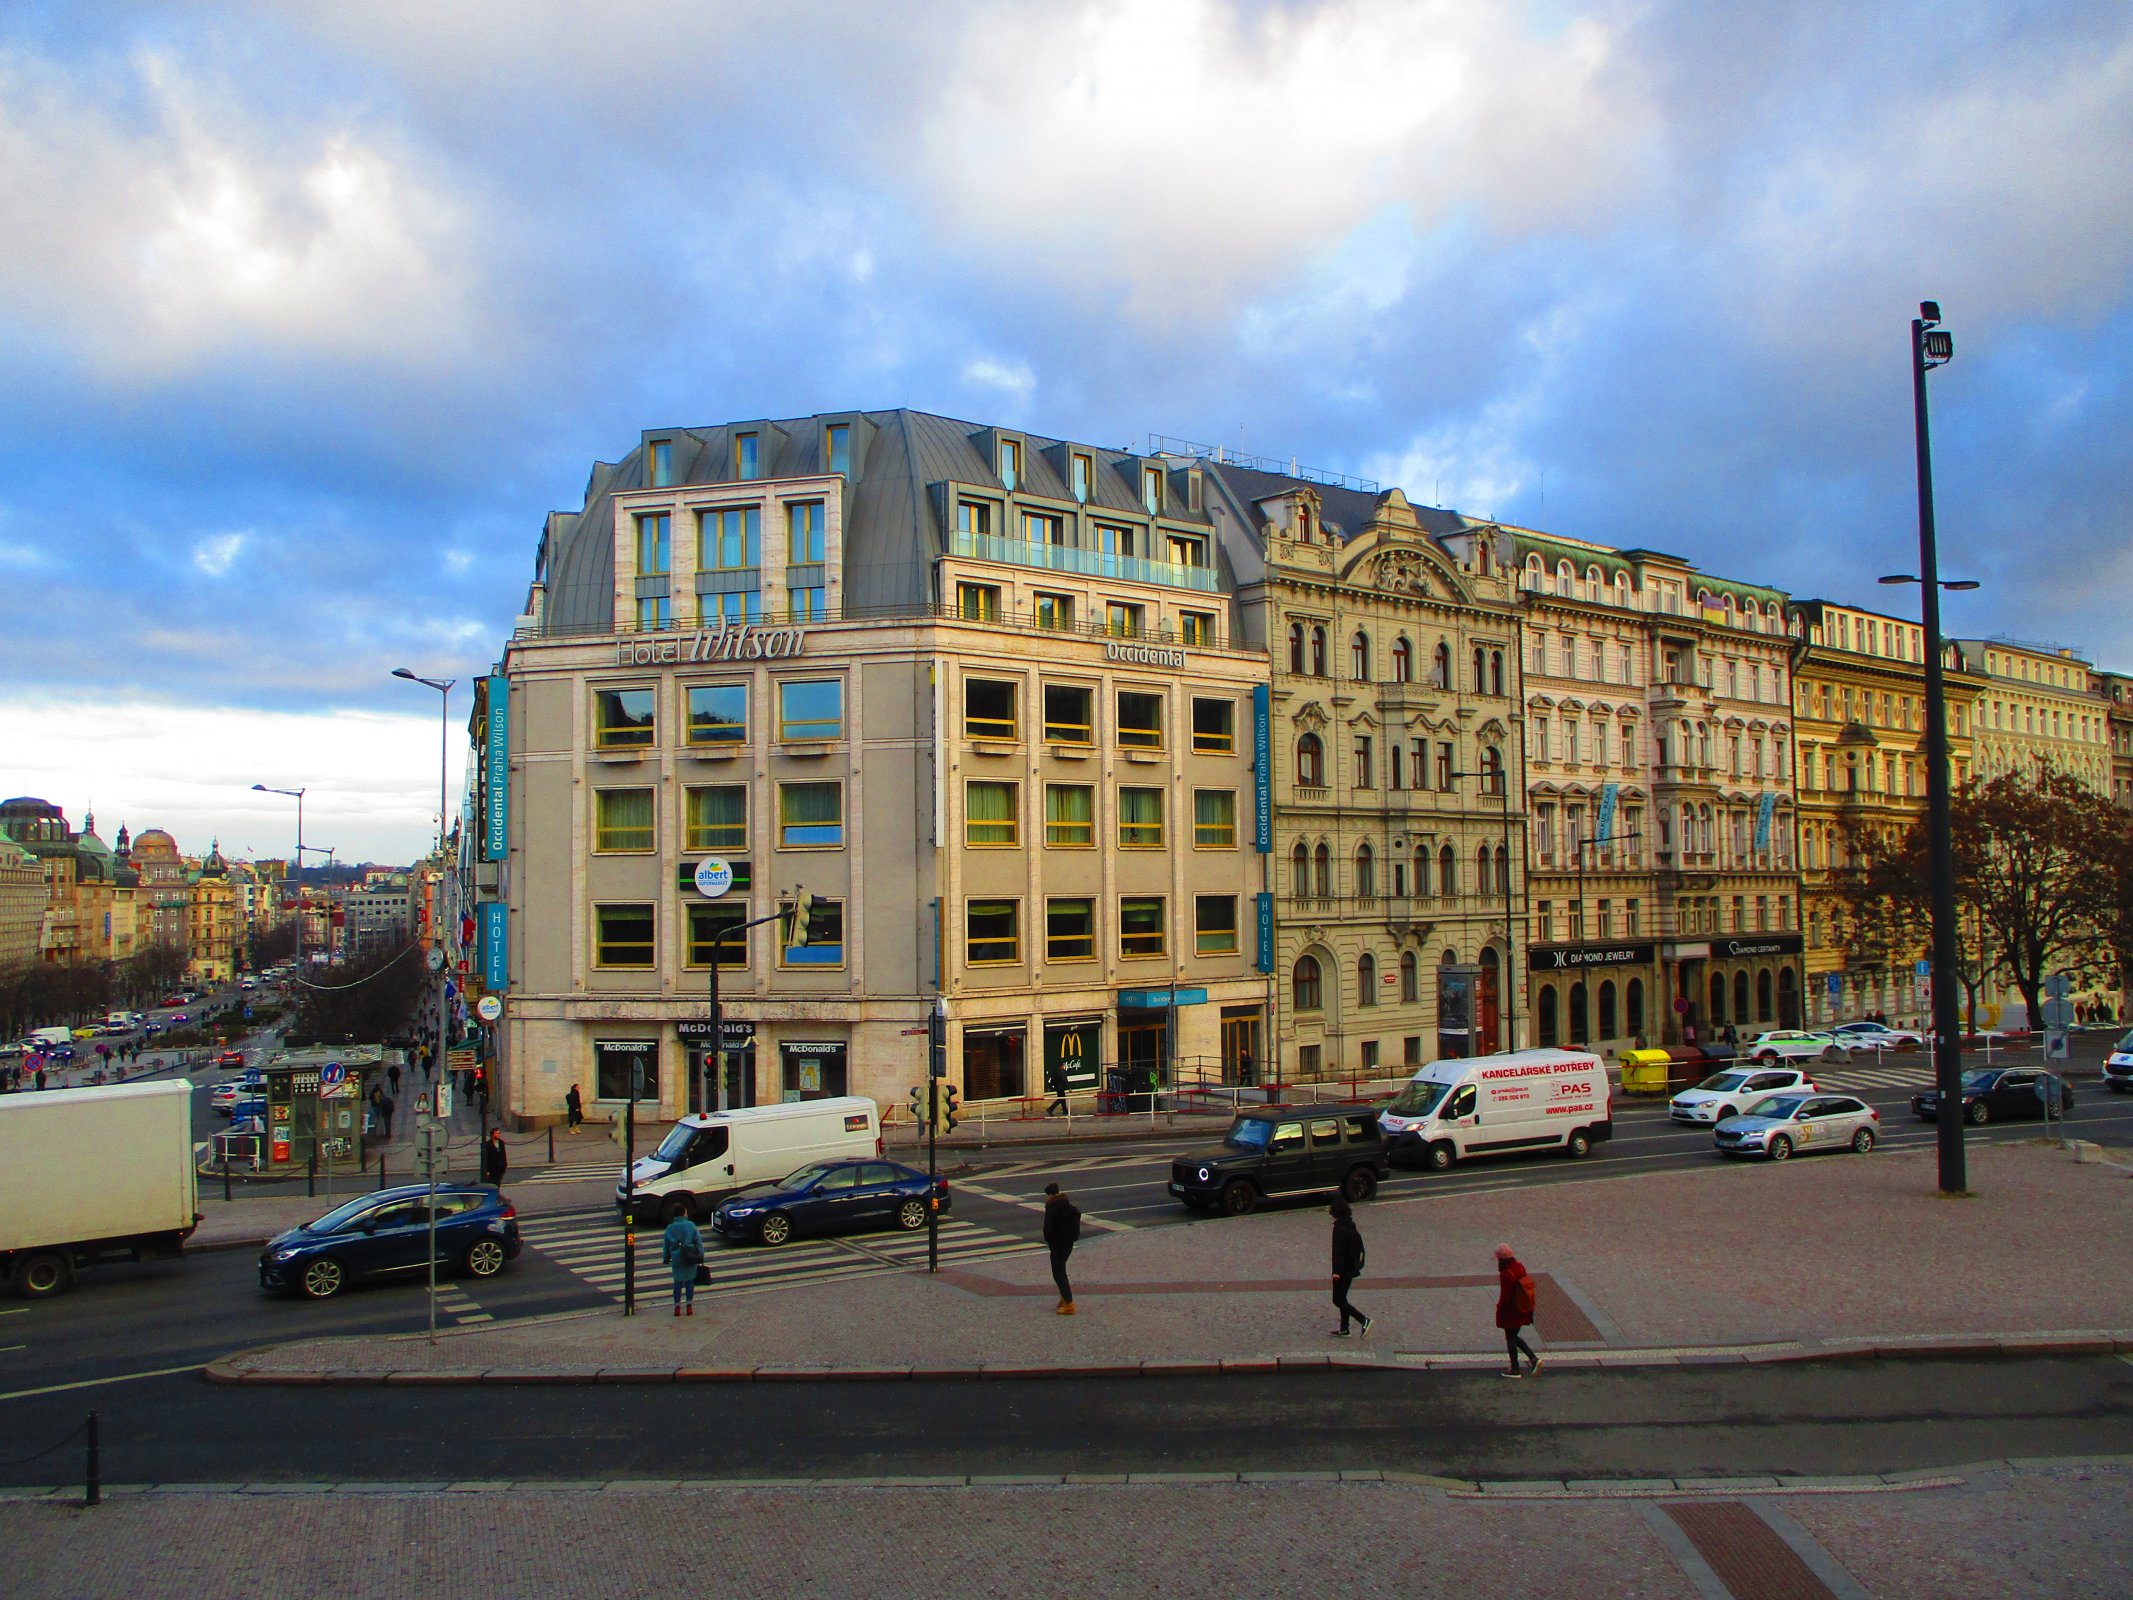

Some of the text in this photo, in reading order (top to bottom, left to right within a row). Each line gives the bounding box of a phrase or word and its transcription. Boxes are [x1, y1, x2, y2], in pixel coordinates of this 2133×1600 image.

[617, 614, 805, 665] Hotel Wilson
[1107, 642, 1187, 667] Occidental
[492, 708, 503, 850] Occidental Praha Wilson
[1257, 713, 1268, 845] Occidental Praha Wilson
[698, 870, 728, 879] albert
[1261, 901, 1269, 965] HOTEL
[492, 912, 501, 982] HOTEL
[1605, 951, 1635, 961] JEWELRY
[678, 1023, 753, 1033] McDald's
[789, 1045, 837, 1053] McDonald's
[1481, 1060, 1595, 1079] KANCELÁŘSKÉ POTŘEBY
[1561, 1083, 1592, 1094] PAS
[1545, 1103, 1594, 1115] www.pas.cz
